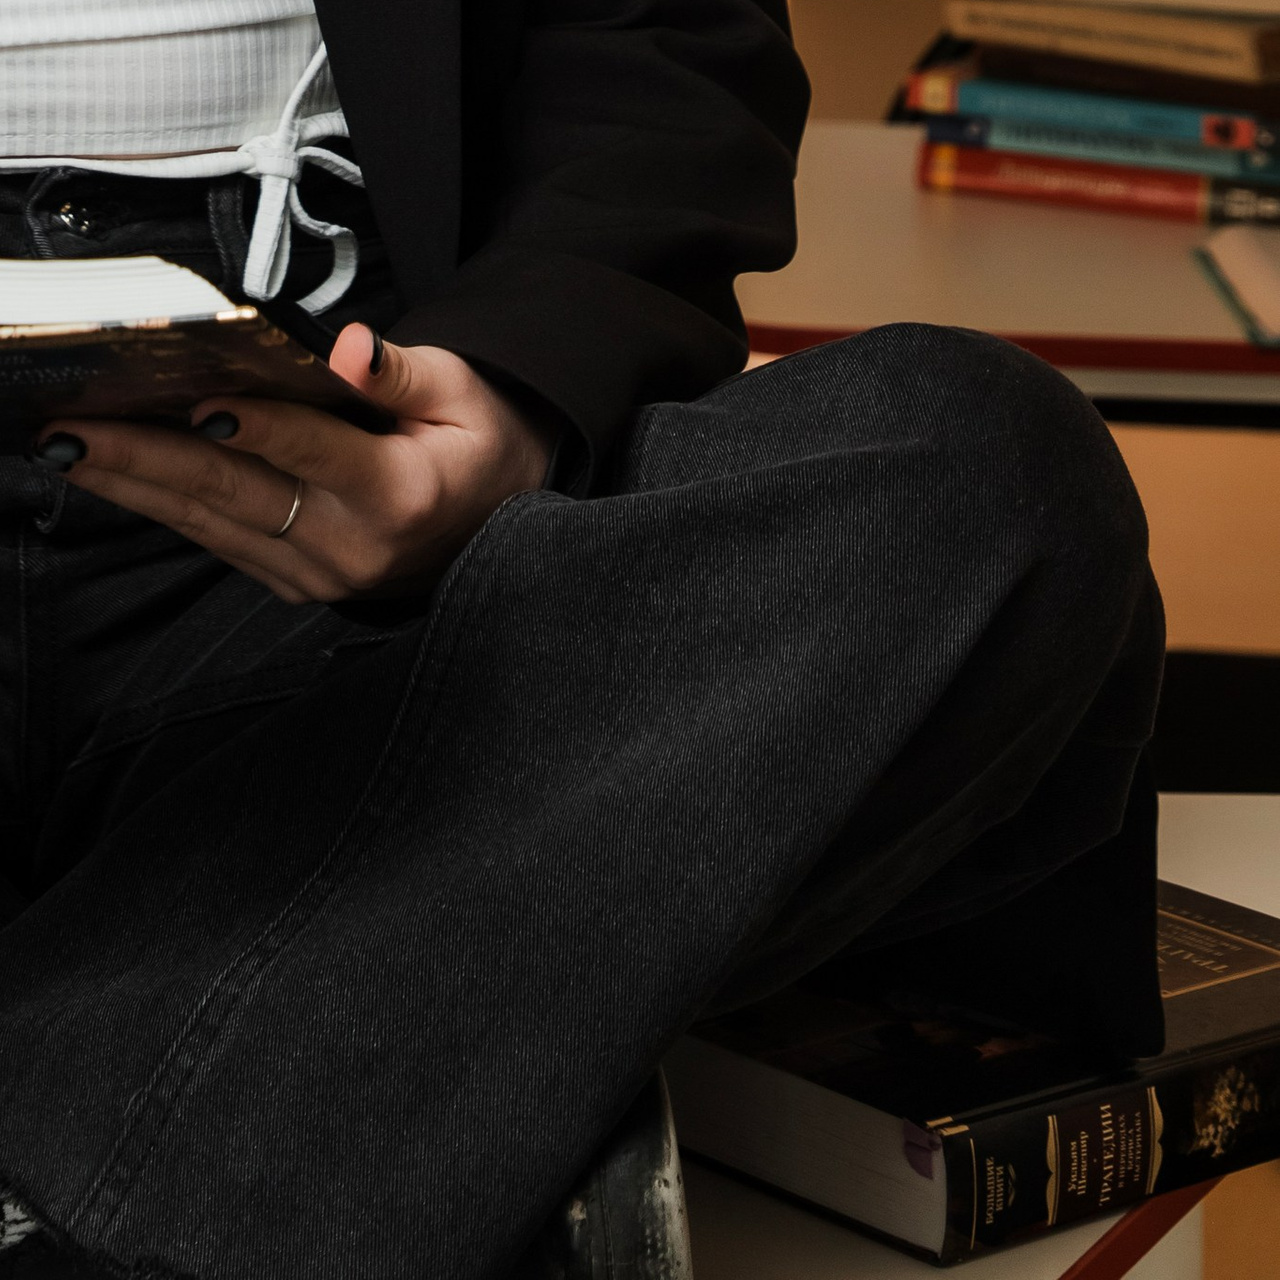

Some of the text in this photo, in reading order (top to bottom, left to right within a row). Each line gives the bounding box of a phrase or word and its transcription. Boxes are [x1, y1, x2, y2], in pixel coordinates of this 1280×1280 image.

[1067, 1141, 1078, 1192] Уильям
[1076, 1130, 1089, 1195] Шекспир
[1098, 1103, 1116, 1207] ТРАГЕДИИ
[984, 1156, 995, 1224] БОЛЬШИЕ
[994, 1165, 1005, 1212] КНИГИ
